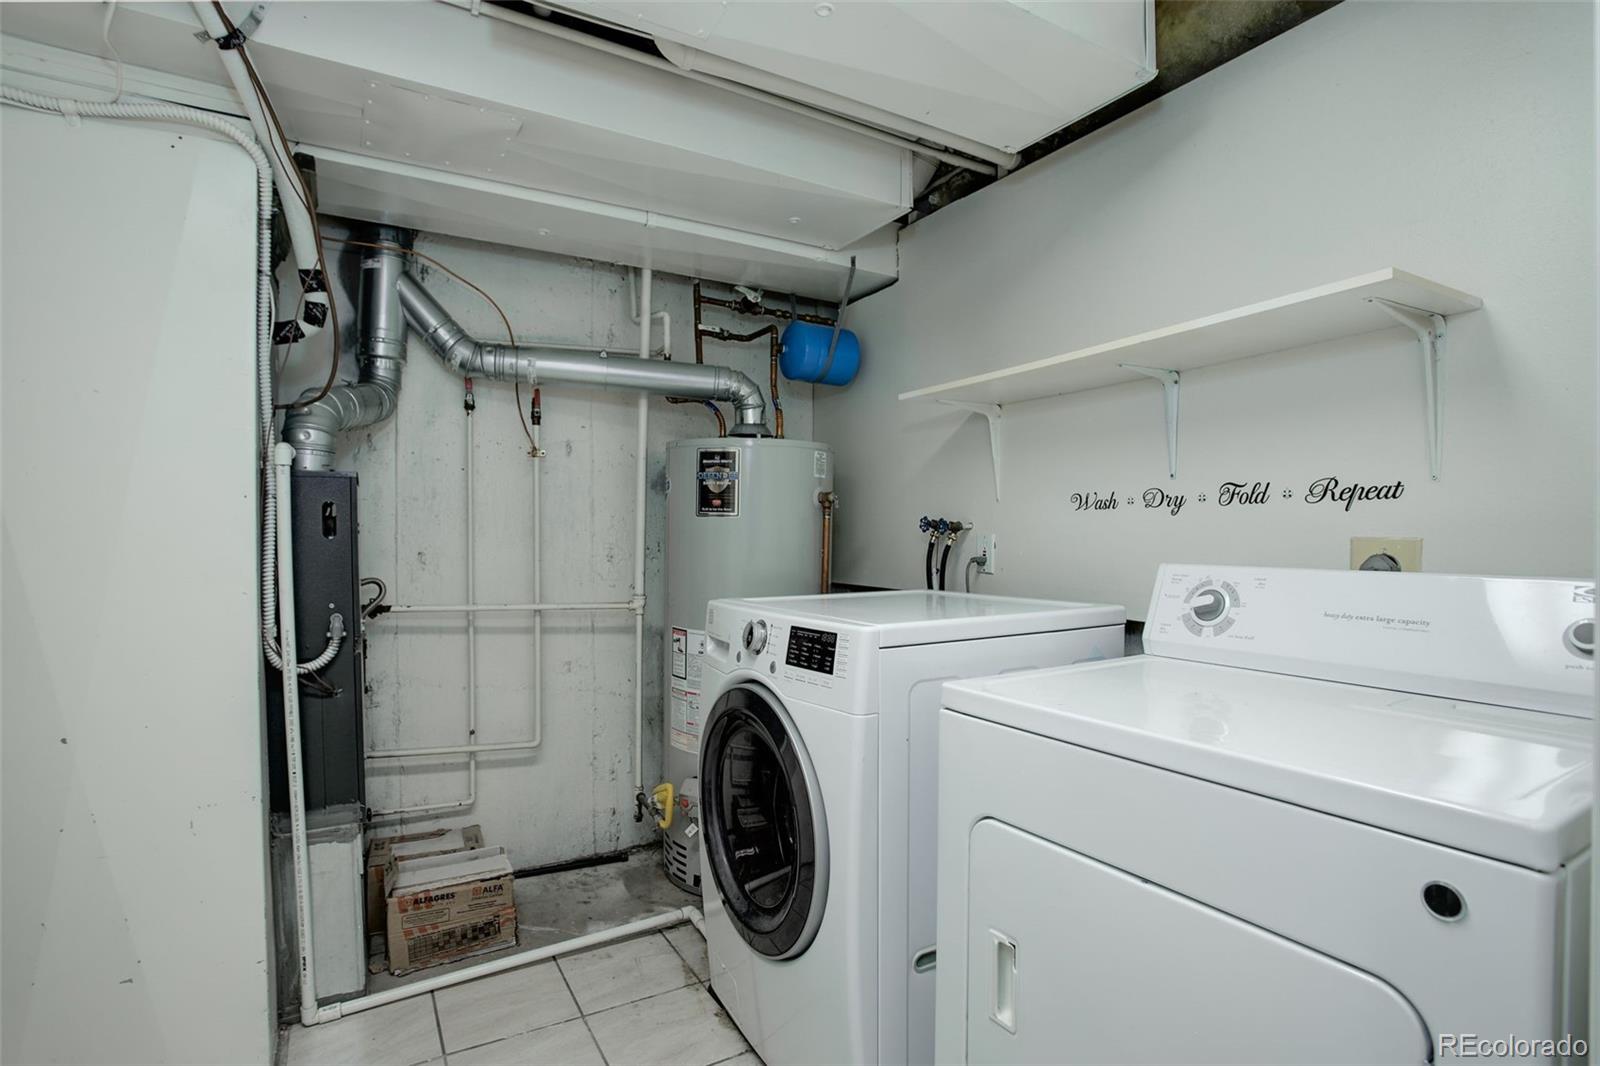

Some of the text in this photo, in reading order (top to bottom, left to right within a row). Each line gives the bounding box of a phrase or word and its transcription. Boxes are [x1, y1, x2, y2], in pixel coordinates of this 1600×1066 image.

[1070, 475, 1406, 517] Wash Dry Fold Repeat
[1355, 614, 1374, 622] extra
[1376, 615, 1395, 624] large
[1397, 618, 1430, 628] capacity
[482, 883, 504, 894] ALFA
[413, 891, 456, 905] ALFAGRES
